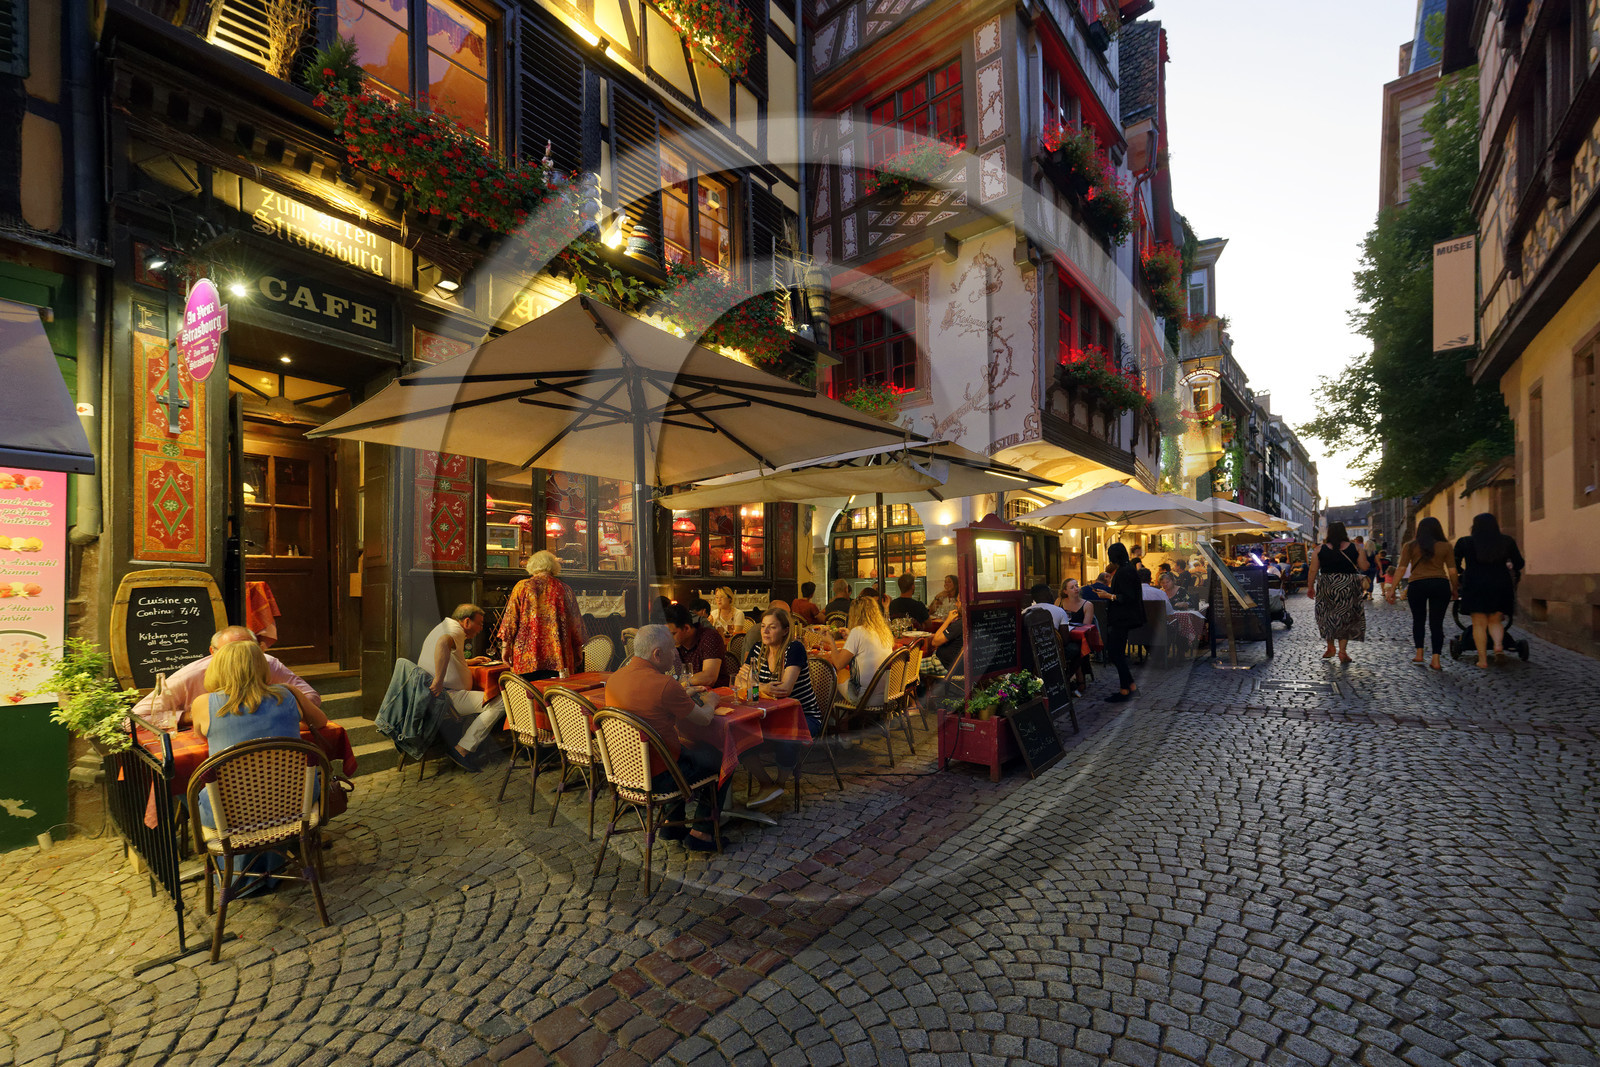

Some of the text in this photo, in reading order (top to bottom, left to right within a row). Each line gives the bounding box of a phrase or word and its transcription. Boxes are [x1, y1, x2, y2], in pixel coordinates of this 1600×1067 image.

[261, 188, 305, 222] Zum
[251, 207, 384, 277] Strassburg
[1436, 240, 1473, 257] MUSEE
[258, 275, 377, 330] CAFE
[181, 314, 222, 347] Strasbourg
[138, 596, 181, 606] Cuisine
[139, 632, 188, 641] Kitchen open
